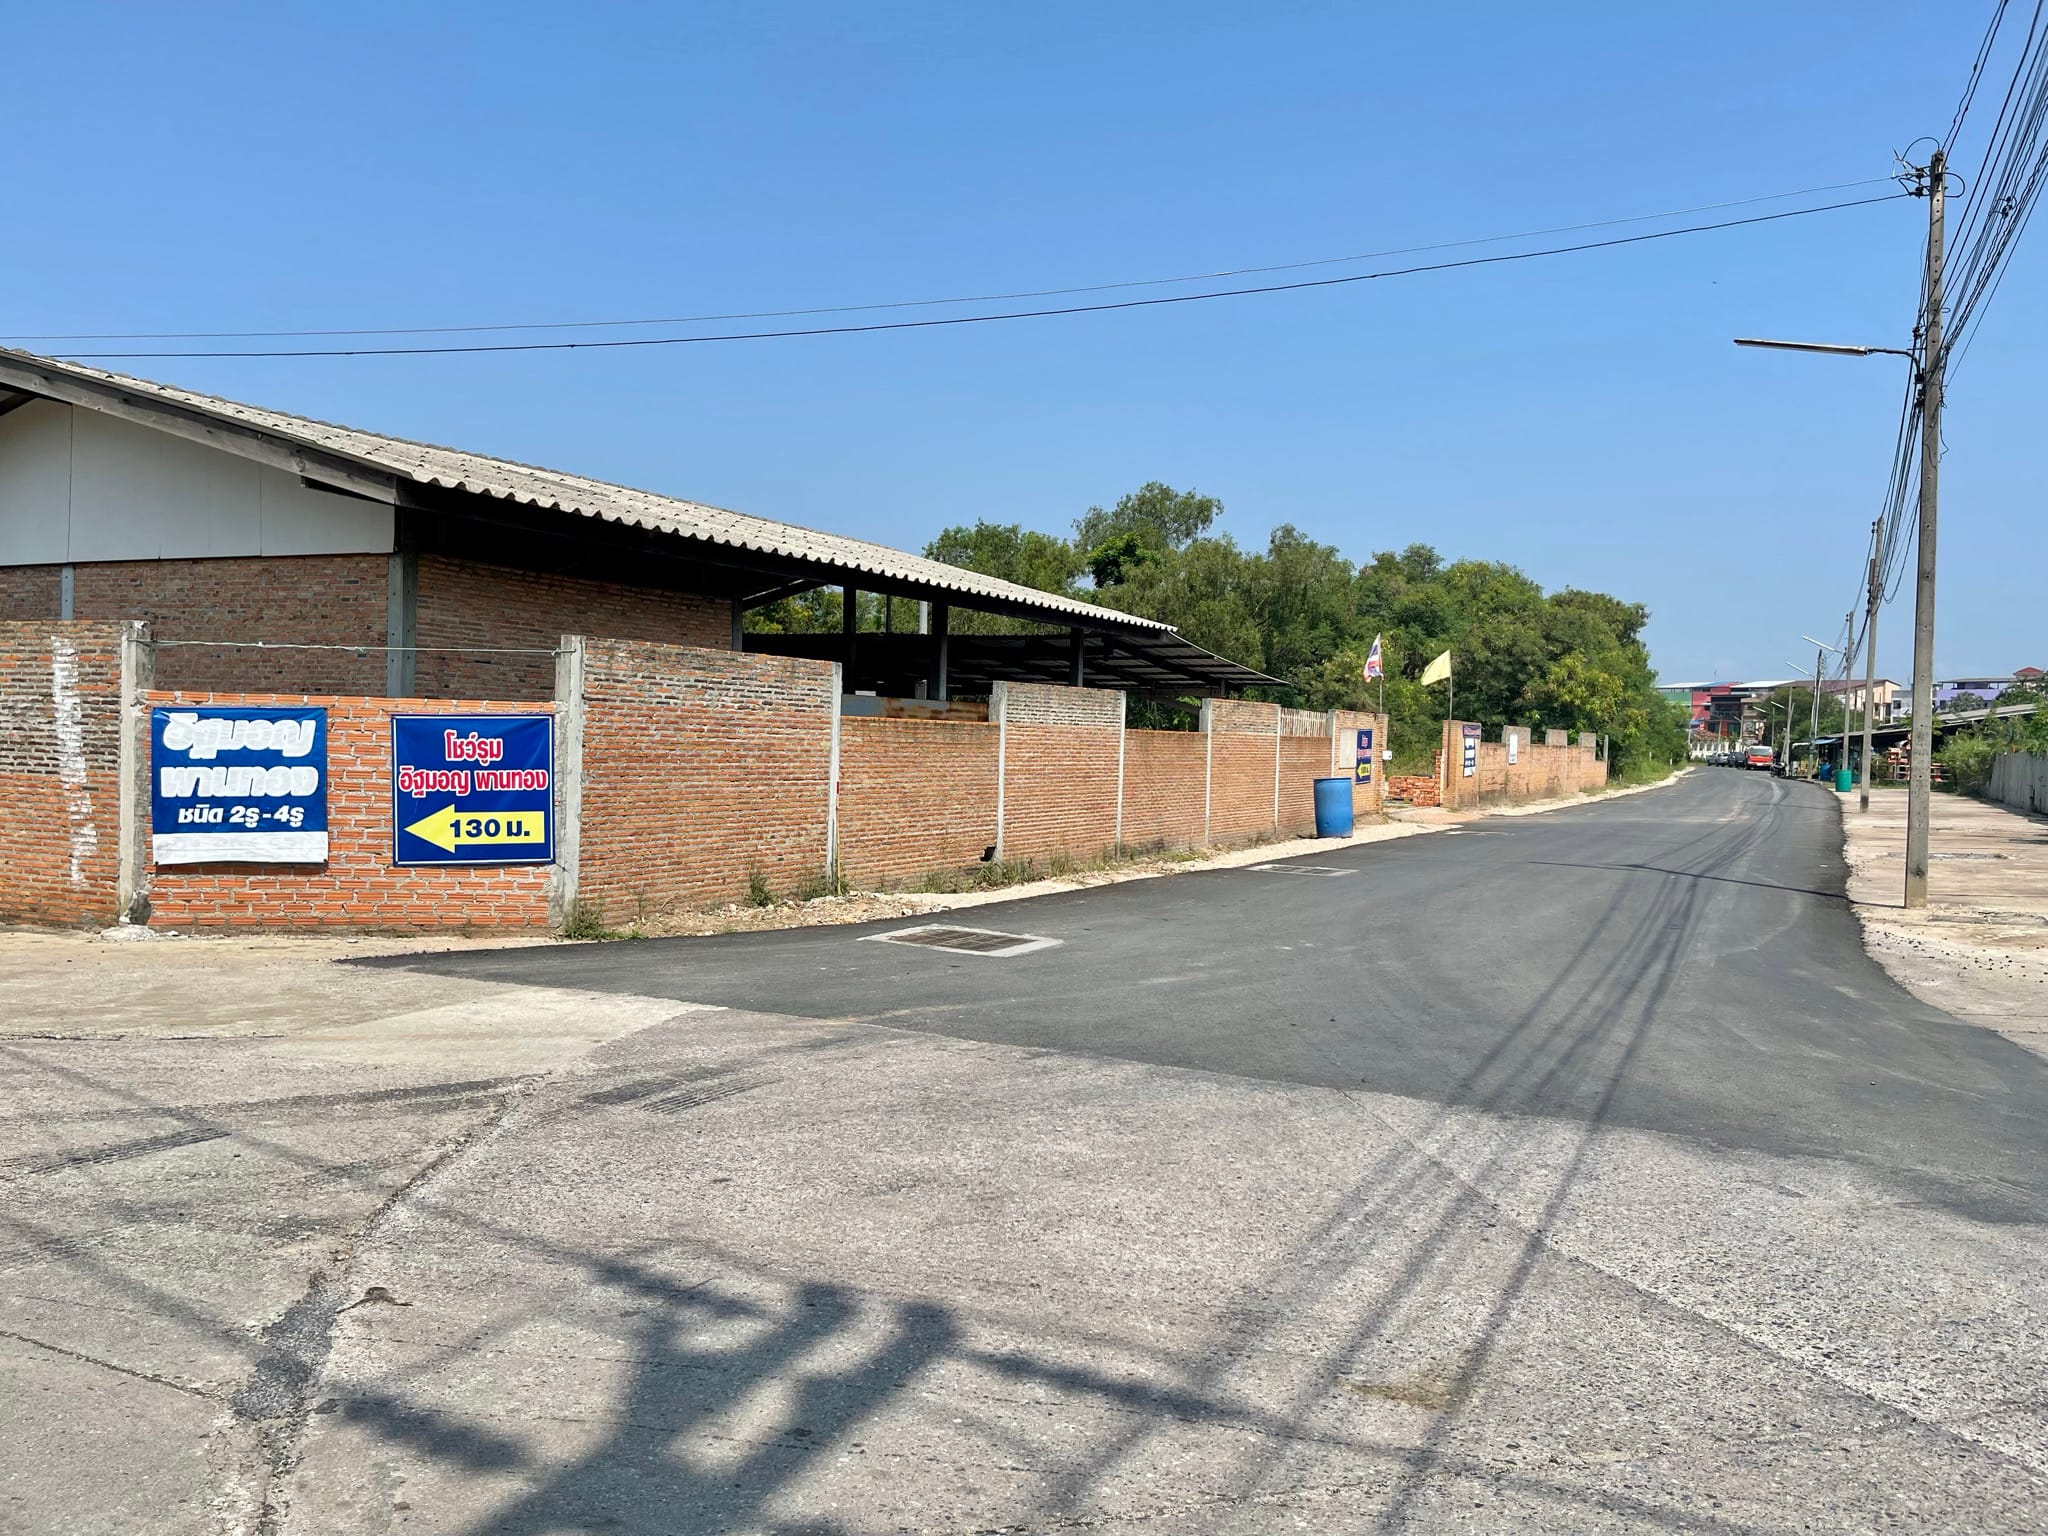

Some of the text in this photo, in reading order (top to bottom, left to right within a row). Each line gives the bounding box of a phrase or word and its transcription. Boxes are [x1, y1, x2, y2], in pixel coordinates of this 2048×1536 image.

[445, 729, 503, 766] โชว์รูม
[161, 766, 319, 797] พานทอง
[399, 766, 549, 798] อิฐมอญ พานทอง
[178, 804, 224, 824] ชนิด
[449, 819, 531, 838] 130 ม.
